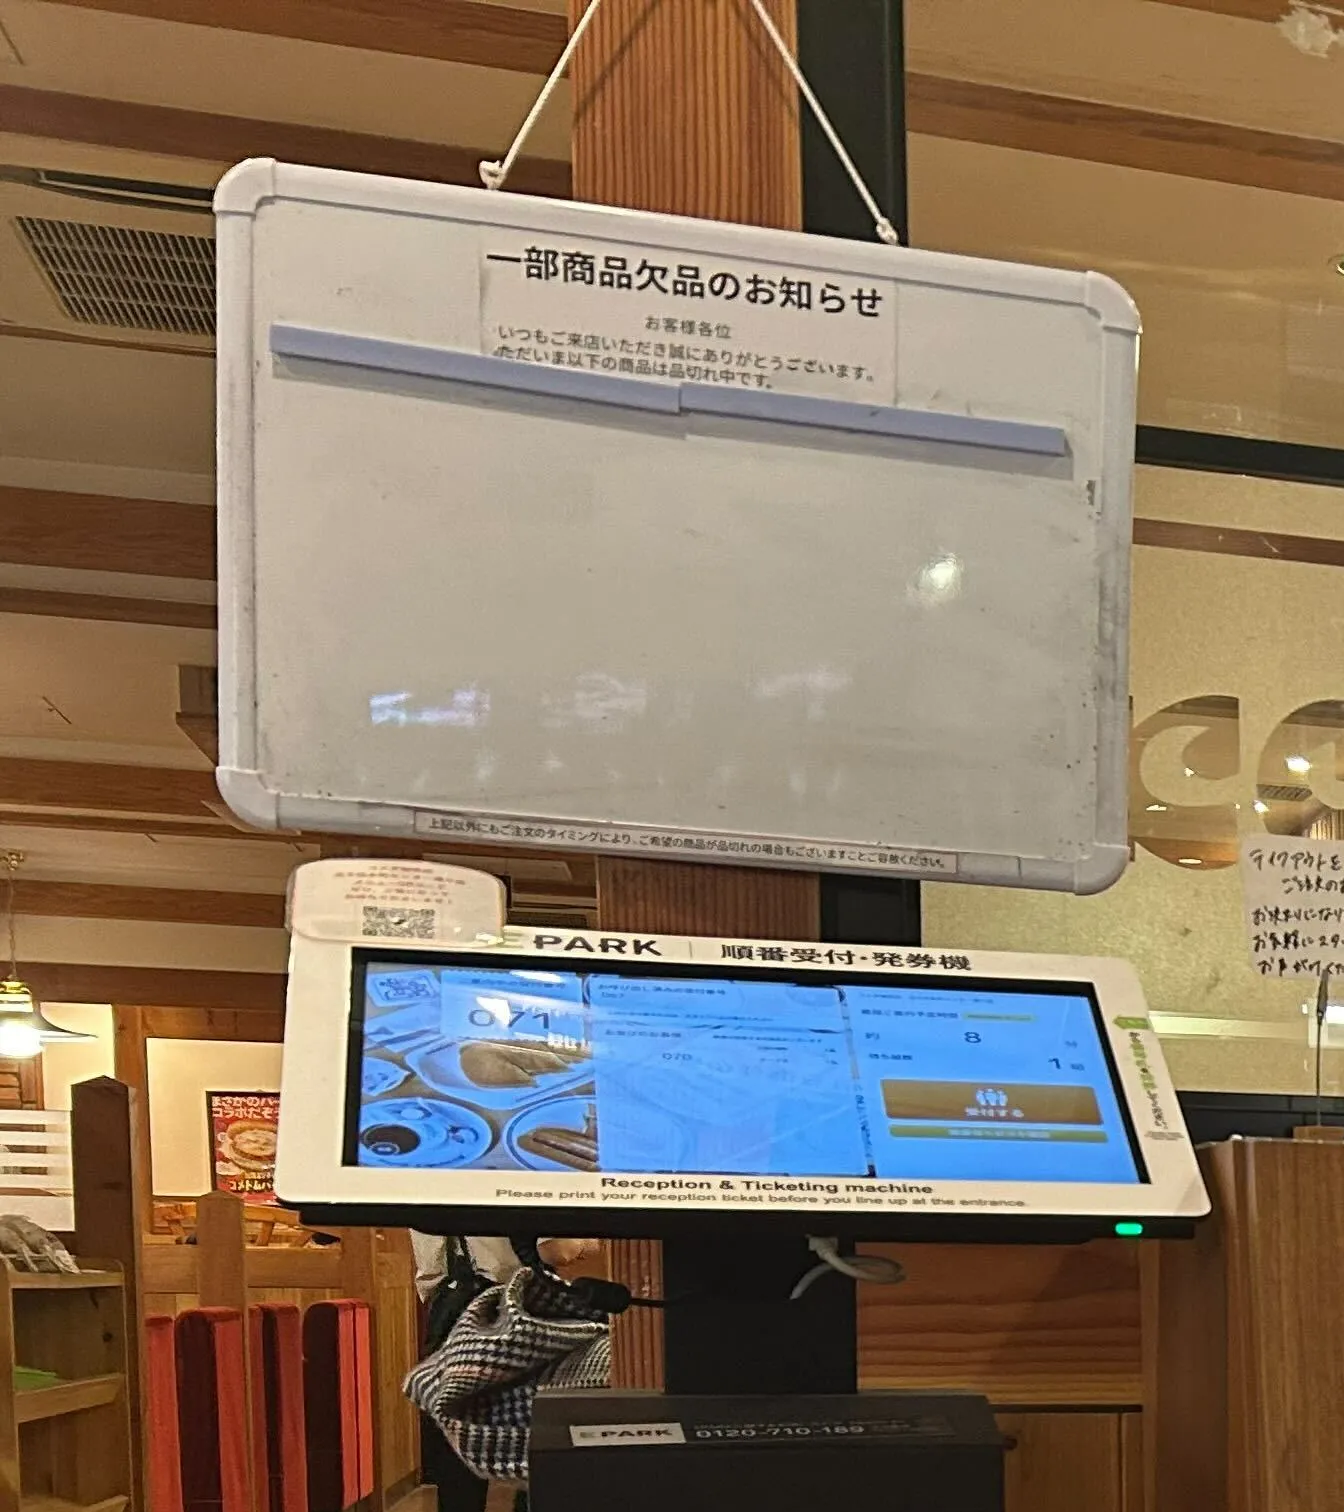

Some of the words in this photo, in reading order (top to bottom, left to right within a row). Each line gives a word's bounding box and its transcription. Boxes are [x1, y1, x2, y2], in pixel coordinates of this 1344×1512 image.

[486, 246, 884, 318] 一部商品欠品のお知らせ
[644, 315, 733, 340] お客様各位
[497, 324, 875, 384] いつもご来店いただき誠にありがとうございます。
[720, 944, 973, 972] 順番受付・発券機
[963, 1031, 982, 1045] 8
[600, 1176, 713, 1193] Reception
[718, 1180, 735, 1191] &
[740, 1179, 840, 1195] Ticketing
[844, 1182, 934, 1195] machine
[495, 1188, 553, 1199] Please
[558, 1190, 596, 1202] print
[600, 1192, 637, 1203] your
[641, 1192, 717, 1204] reception
[768, 1194, 819, 1205] before
[822, 1197, 852, 1208] you
[855, 1196, 883, 1206] line
[695, 1425, 867, 1440] 0120-710-189
